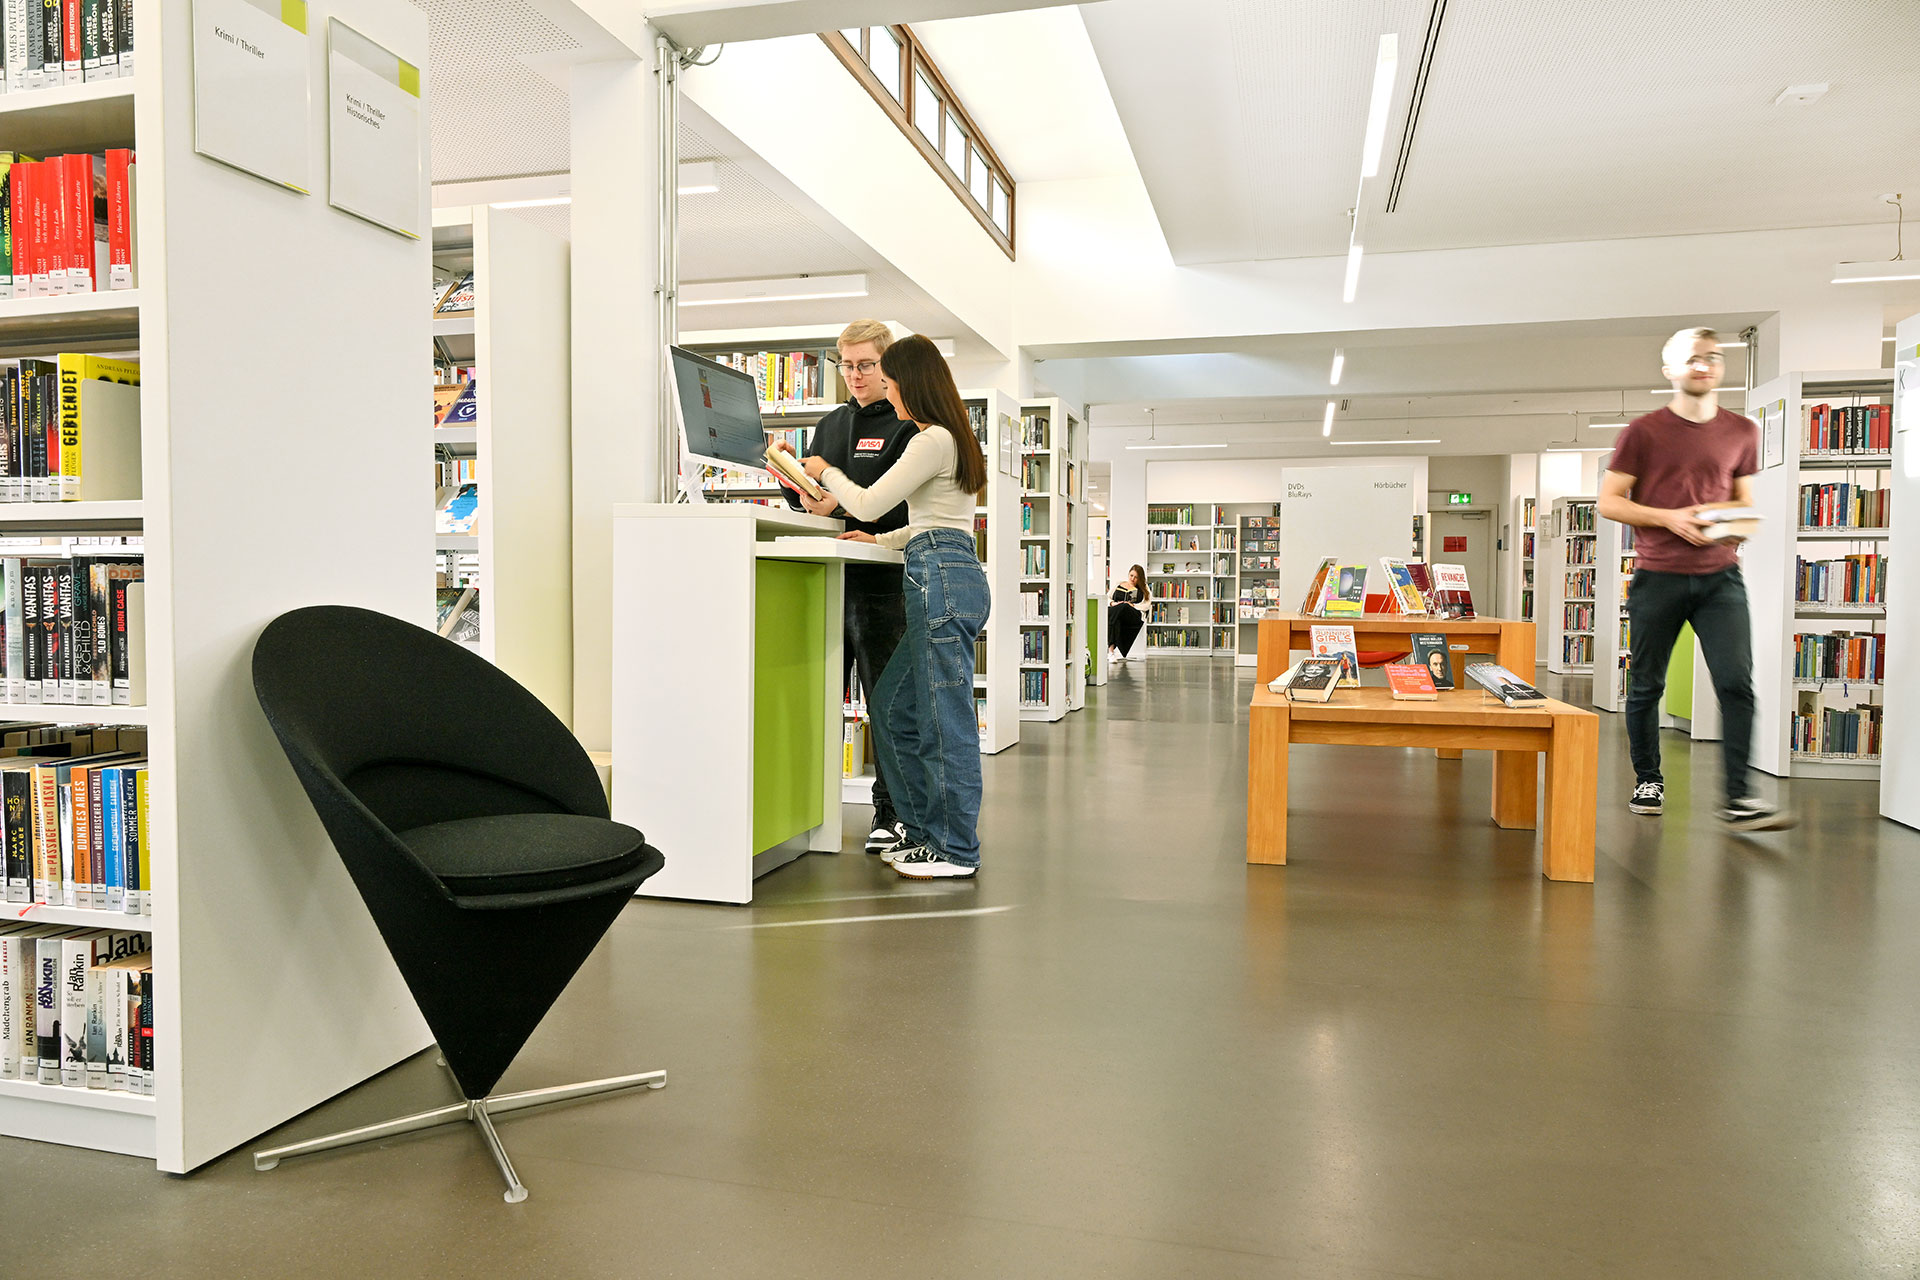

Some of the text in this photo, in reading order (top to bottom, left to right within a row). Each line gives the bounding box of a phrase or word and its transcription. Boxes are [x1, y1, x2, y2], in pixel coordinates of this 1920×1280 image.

[9, 34, 18, 63] JAMES
[215, 26, 235, 44] Krimi
[241, 40, 265, 59] Thriller
[346, 94, 361, 107] Krimi
[366, 104, 385, 120] Thriller
[346, 105, 380, 129] Historisches
[62, 369, 78, 446] GEBLENDET
[1288, 491, 1312, 499] BluRays
[1374, 481, 1407, 489] Hörbücher
[74, 573, 82, 606] GRAVE
[1440, 572, 1466, 583] REVANCHE
[24, 576, 37, 619] VANITAS
[43, 576, 55, 619] VANITAS
[60, 575, 72, 618] VANITAS
[97, 616, 106, 638] BONES
[1316, 635, 1352, 643] GIRLS
[42, 775, 55, 807] MASKAT
[75, 781, 85, 808] ARLES
[91, 775, 101, 801] MISTRAL
[76, 810, 88, 850] DUNKLES
[93, 803, 103, 850] MÖRDERISCHER
[129, 809, 138, 842] SOMMER
[46, 828, 57, 864] PASSAGE
[43, 958, 52, 1009] RANKIN
[74, 954, 85, 991] Rankin
[2, 980, 11, 1040] Mädchengrab
[25, 993, 33, 1028] RANKIN
